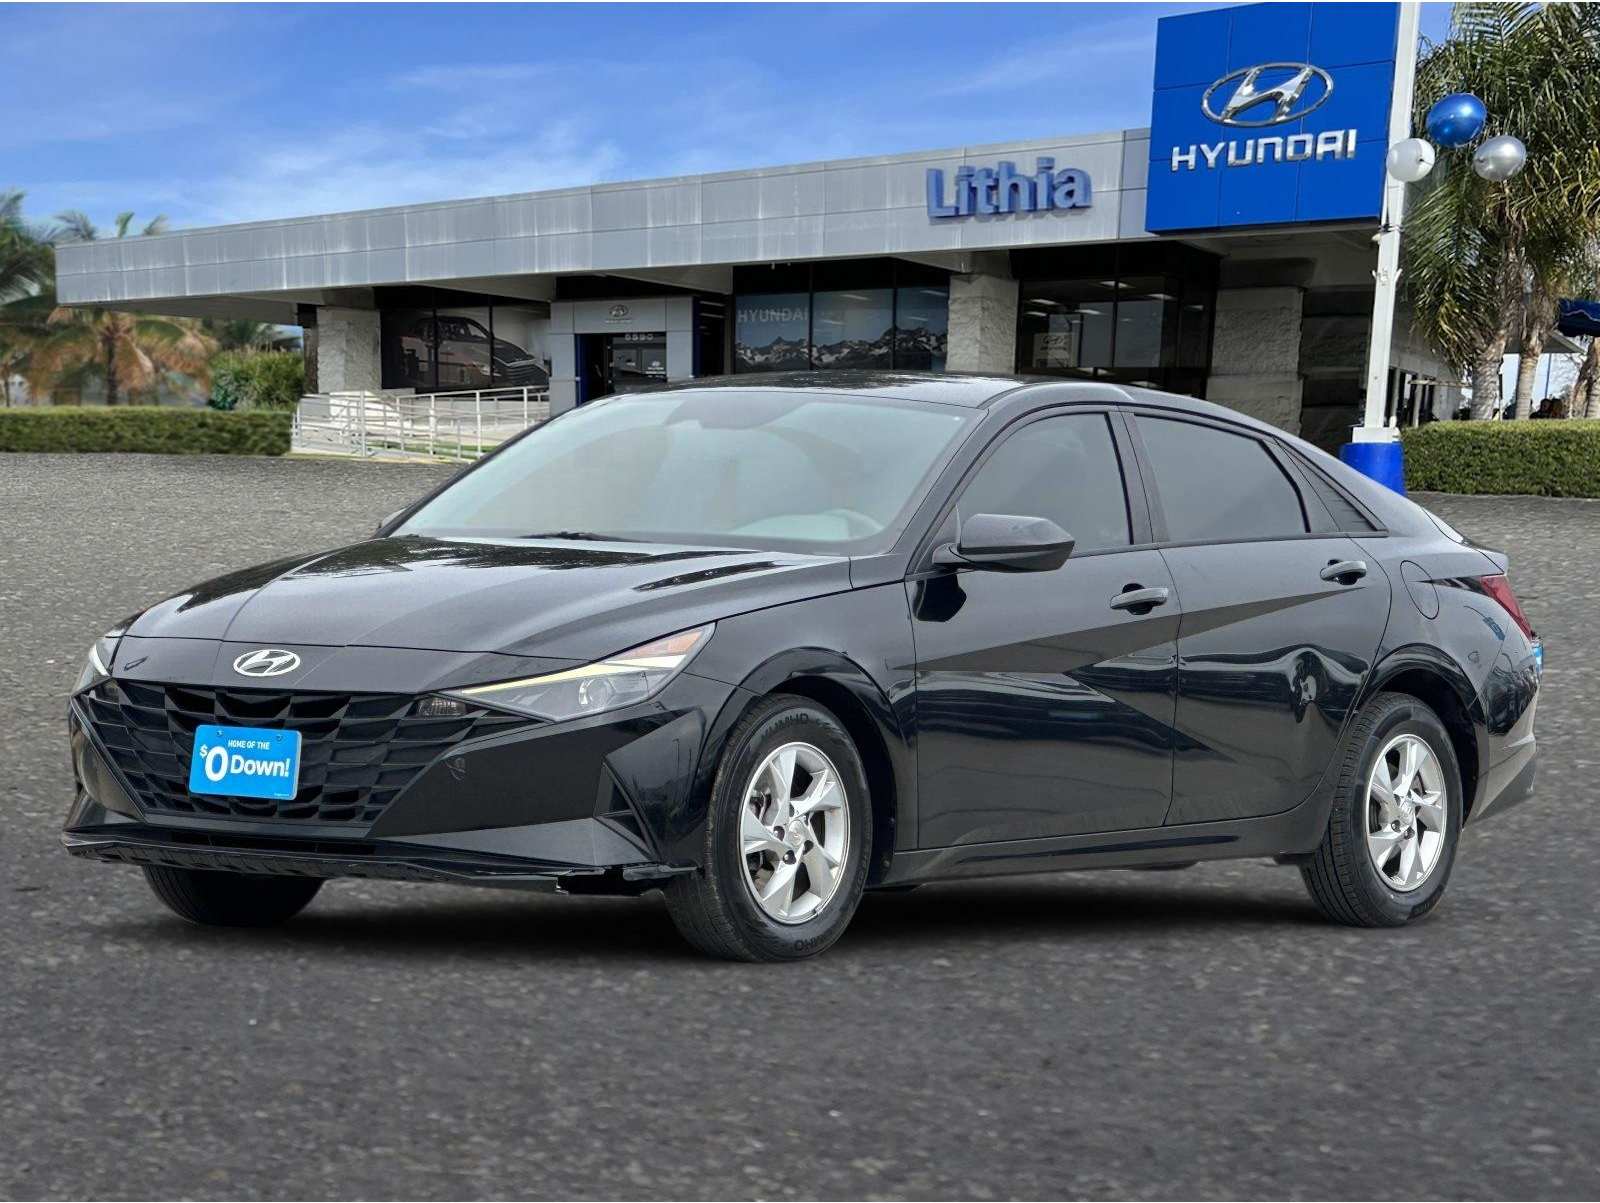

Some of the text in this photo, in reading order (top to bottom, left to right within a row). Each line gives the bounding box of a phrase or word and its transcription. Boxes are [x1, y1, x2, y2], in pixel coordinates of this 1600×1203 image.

[1171, 129, 1357, 172] HYUNDAI
[926, 157, 1093, 218] Lithia
[737, 307, 809, 323] HYUNDAI
[200, 744, 291, 782] $0 Down!
[228, 740, 270, 751] HOME OF THE
